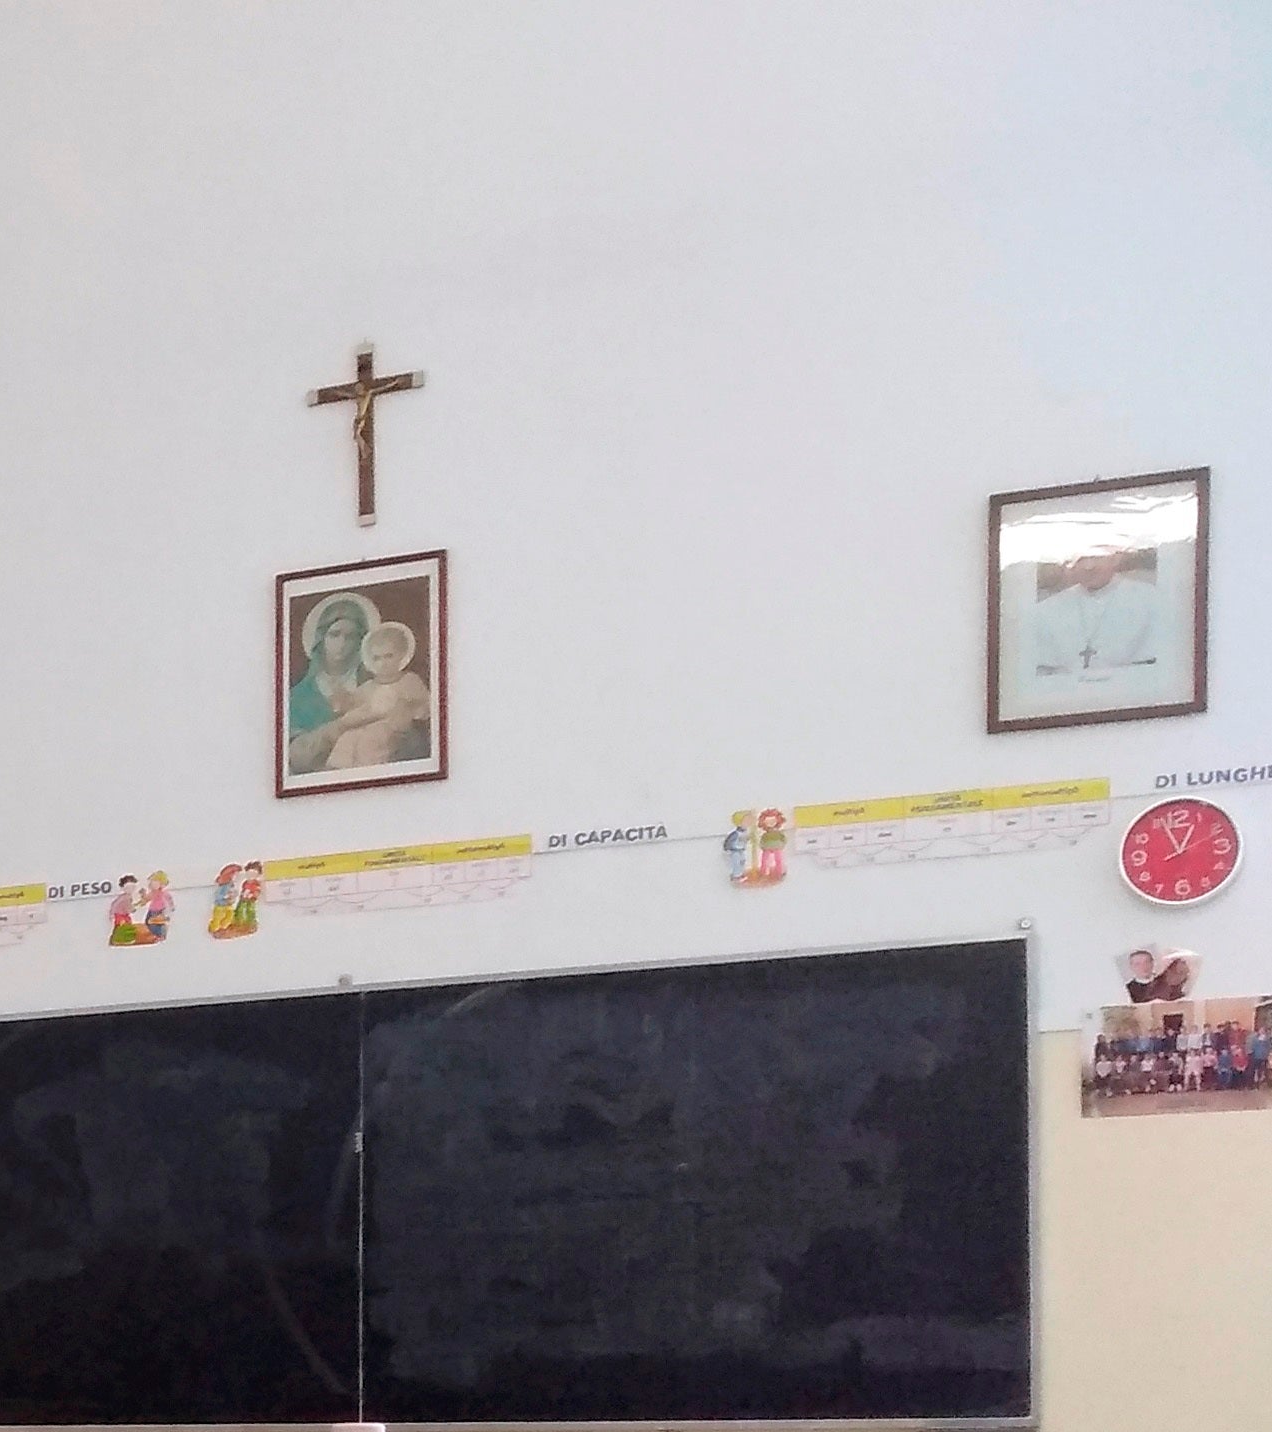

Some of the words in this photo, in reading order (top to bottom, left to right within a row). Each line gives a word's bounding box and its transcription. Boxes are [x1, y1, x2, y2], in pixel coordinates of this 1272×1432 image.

[1155, 773, 1177, 789] DI
[1167, 810, 1190, 829] 12
[549, 834, 567, 849] DI
[1213, 838, 1231, 855] 3
[1131, 850, 1147, 866] 9
[48, 886, 64, 899] DI
[71, 881, 112, 898] PESO
[1174, 879, 1191, 896] 6
